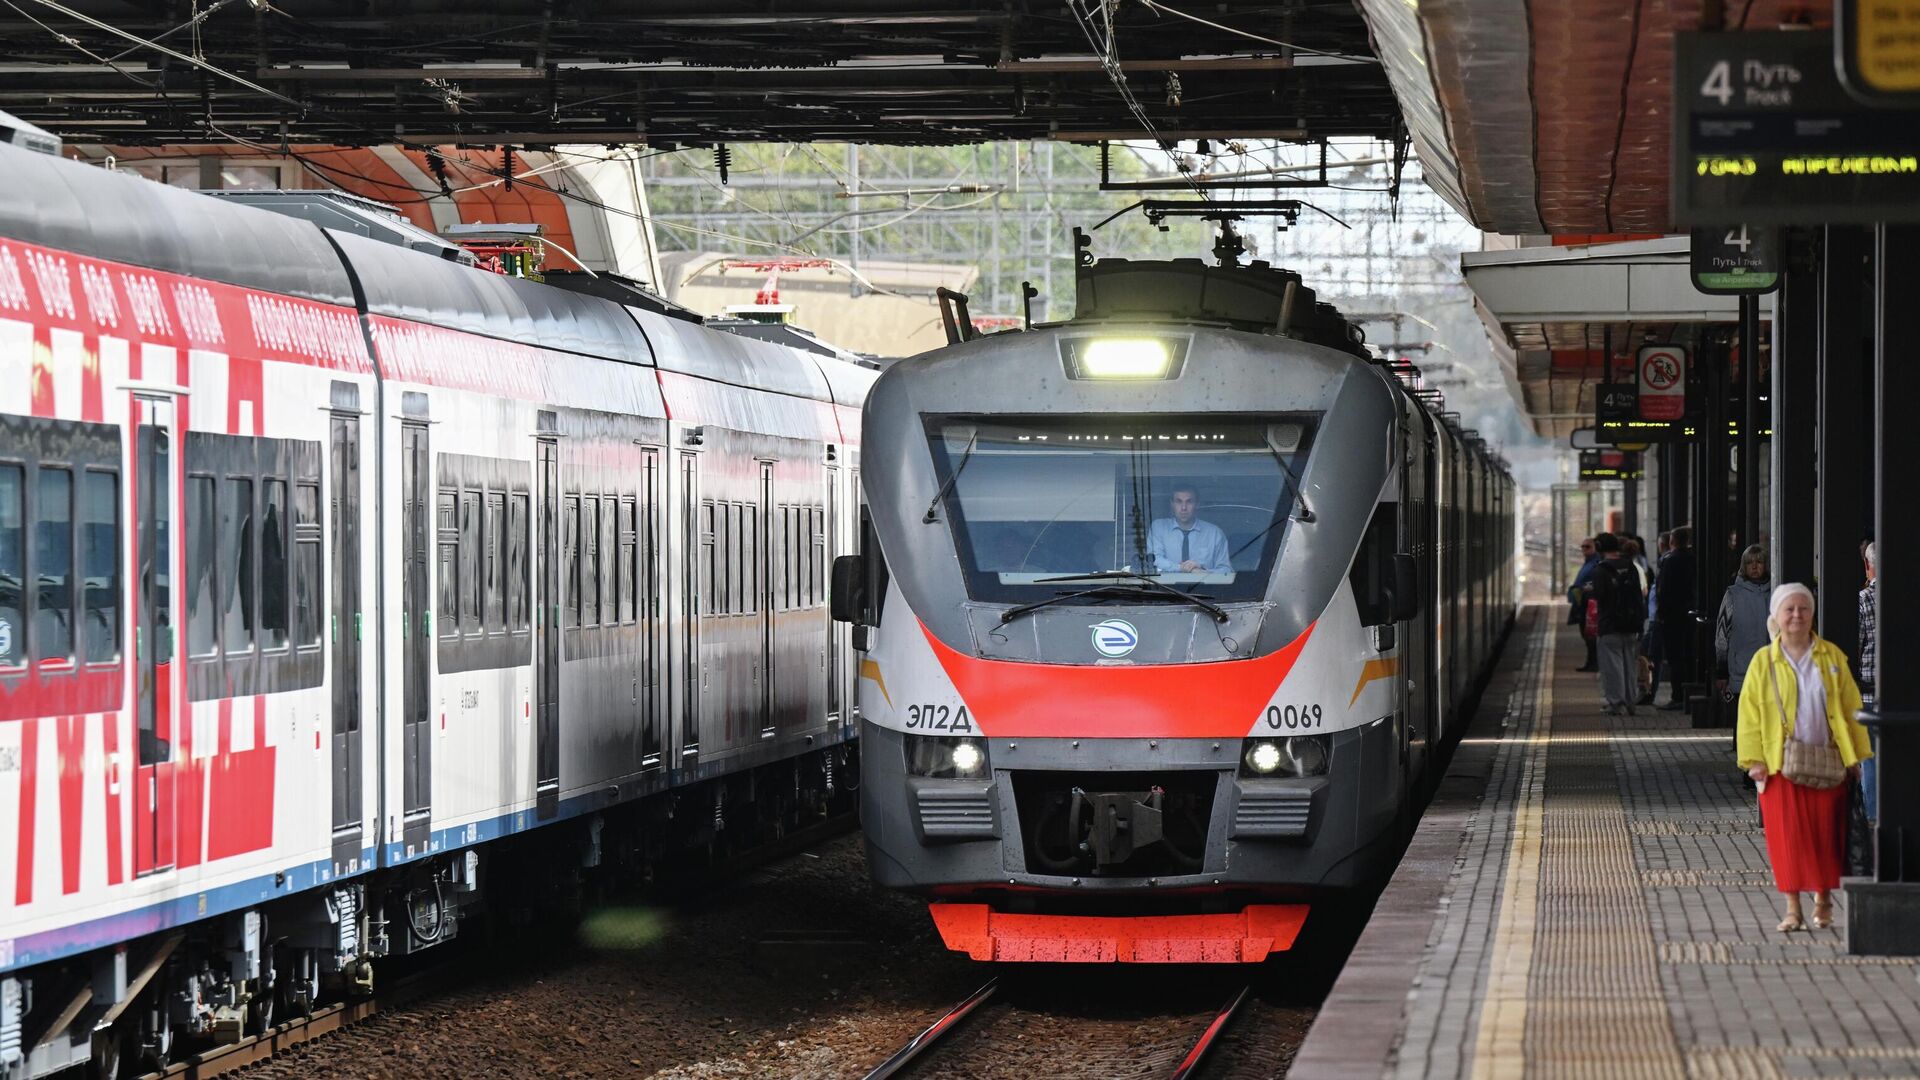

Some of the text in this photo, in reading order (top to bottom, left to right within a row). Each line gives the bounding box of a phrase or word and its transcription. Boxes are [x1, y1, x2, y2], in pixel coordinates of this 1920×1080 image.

[1701, 60, 1801, 105] 4 Путь
[1724, 222, 1752, 253] 4
[1712, 257, 1737, 269] Путь
[1603, 393, 1615, 407] 4
[905, 704, 972, 733] ЭП2Д
[1267, 703, 1322, 730] 0069
